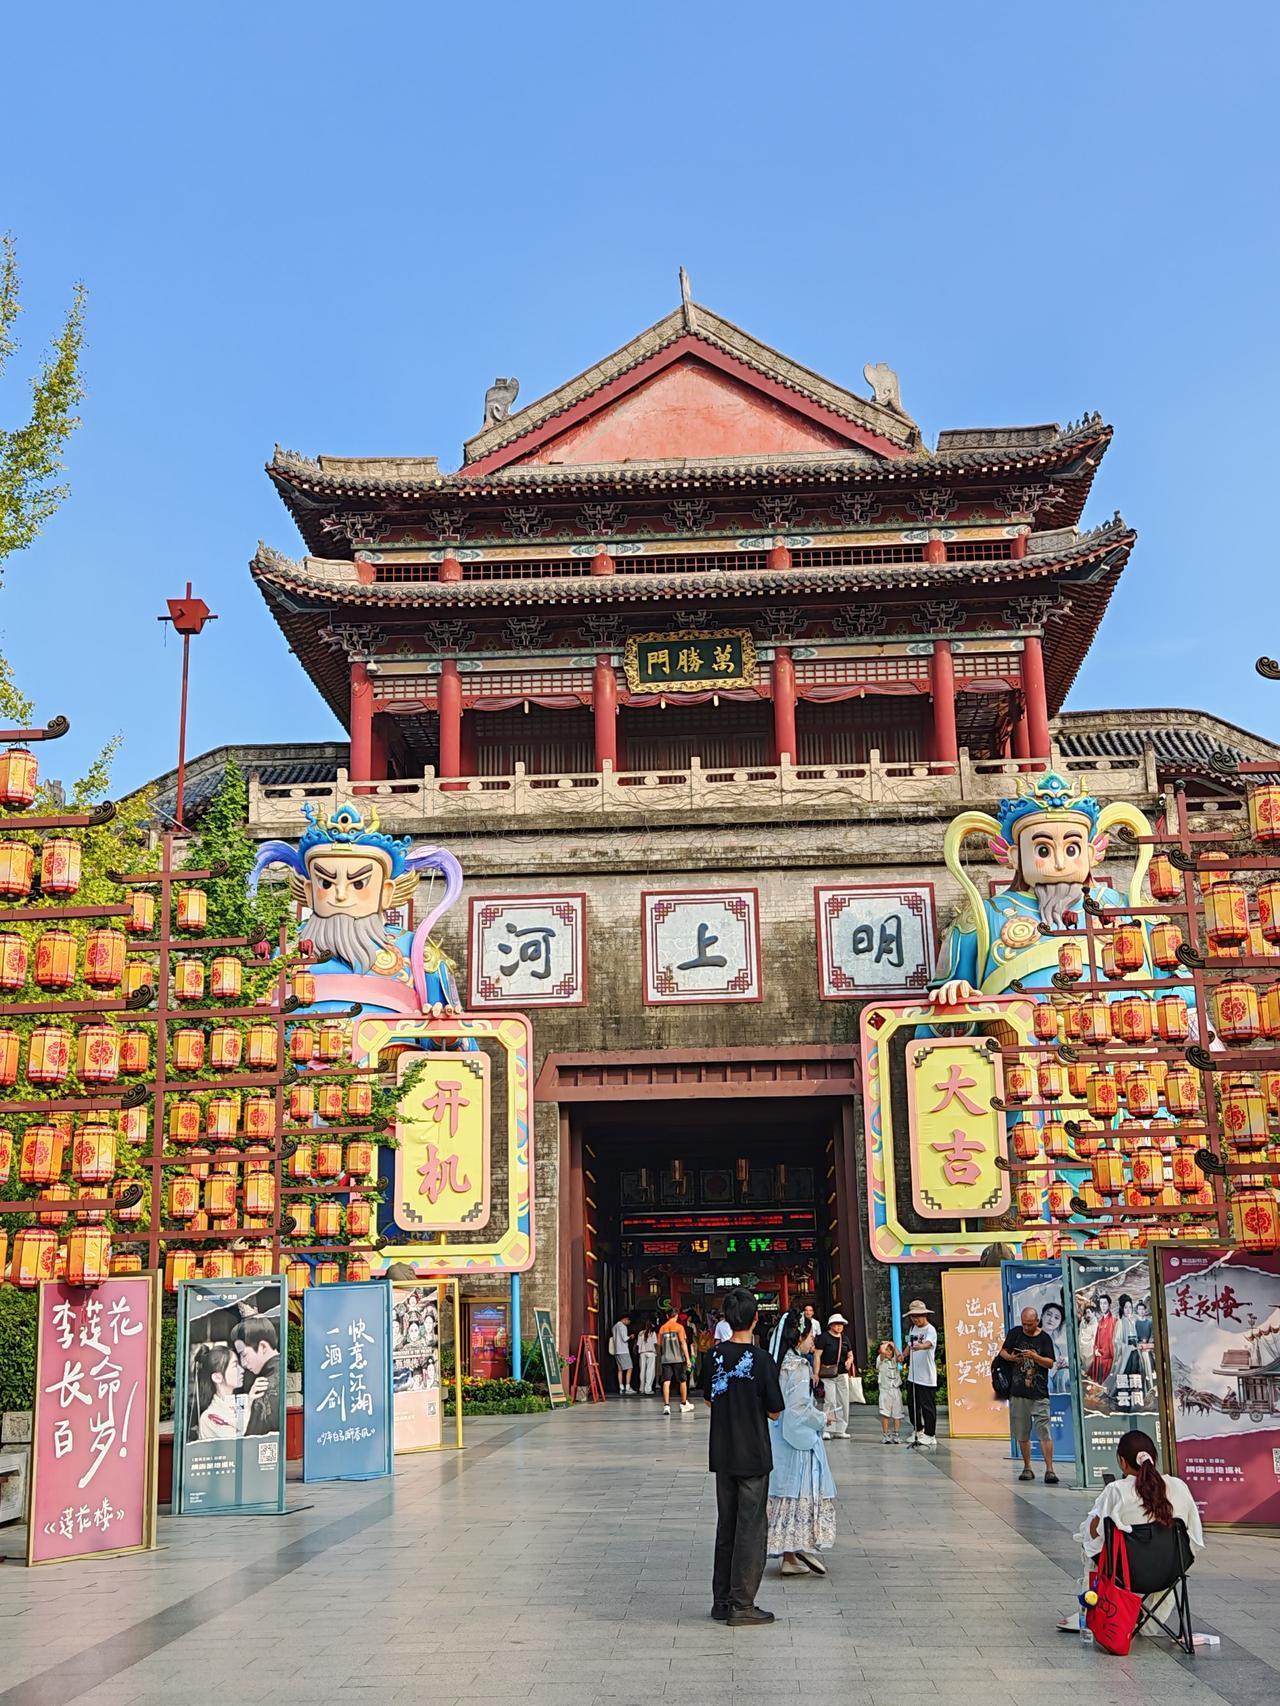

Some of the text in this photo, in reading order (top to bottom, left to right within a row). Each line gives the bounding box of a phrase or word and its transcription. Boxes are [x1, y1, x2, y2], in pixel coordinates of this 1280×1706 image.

[417, 1080, 471, 1204] 开机
[931, 1064, 988, 1185] 大吉
[52, 1296, 143, 1355] 李莲花
[965, 1297, 1000, 1318] 逆风
[316, 1327, 347, 1422] 一酒一剑
[348, 1318, 375, 1415] 快意江湖
